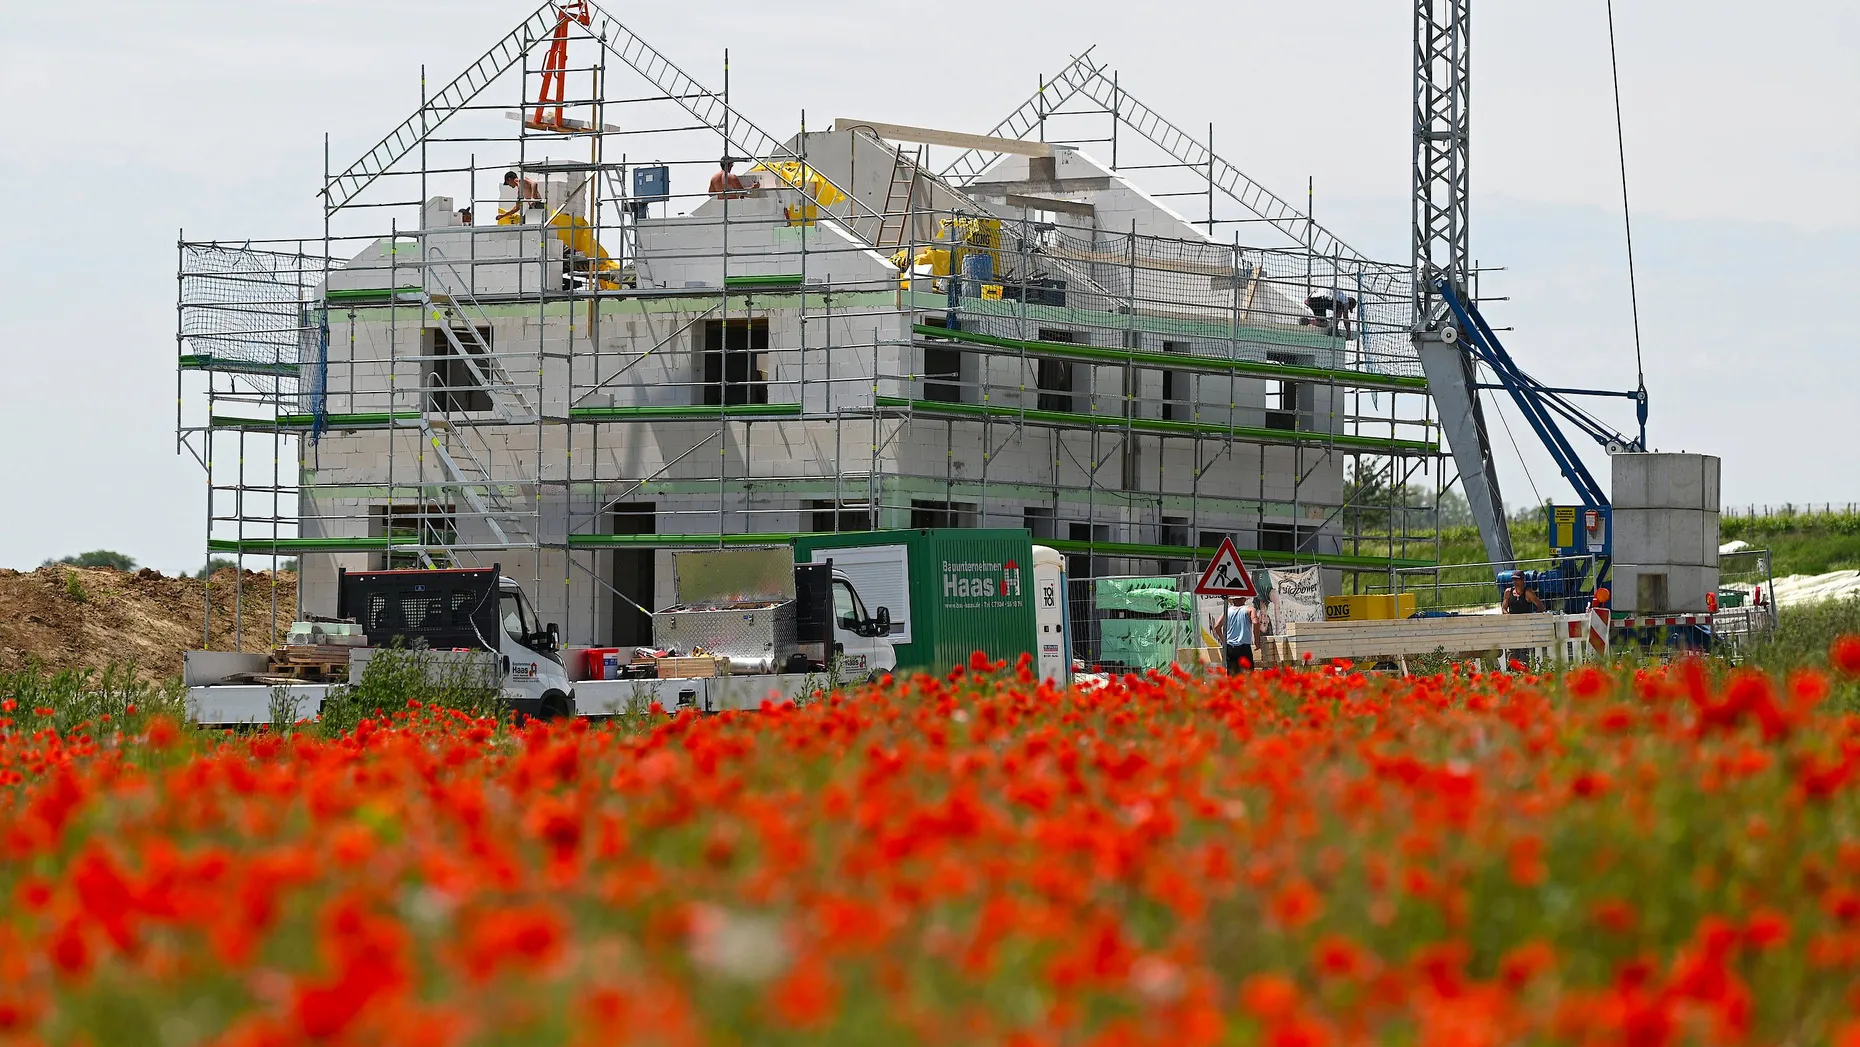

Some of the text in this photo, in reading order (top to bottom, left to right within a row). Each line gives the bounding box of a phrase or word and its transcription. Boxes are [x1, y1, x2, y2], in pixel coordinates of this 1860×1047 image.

[943, 560, 1002, 571] Bauunternehmen
[944, 573, 995, 597] Haas
[1325, 604, 1350, 617] ONG
[512, 666, 529, 674] Haas
